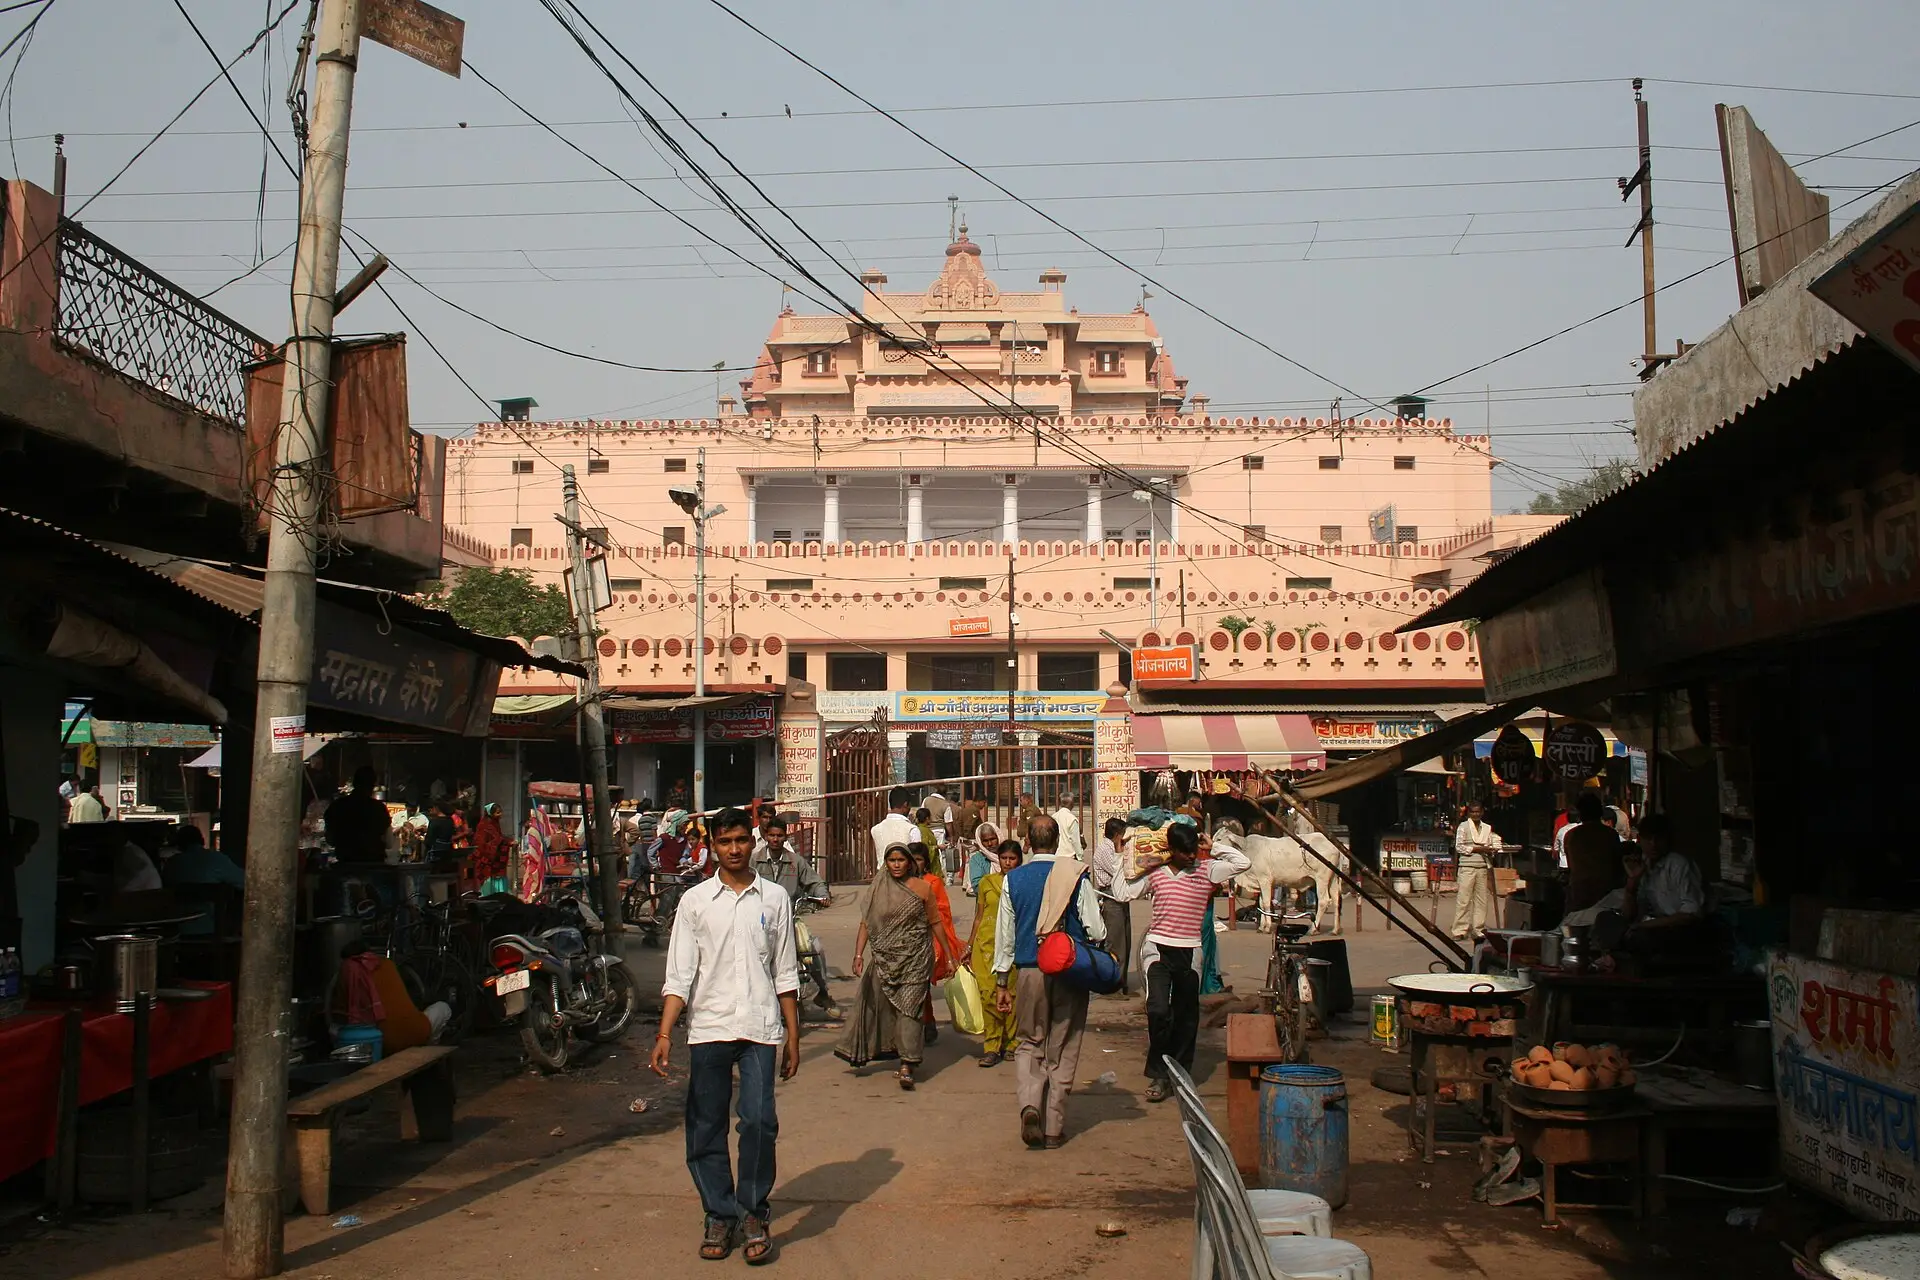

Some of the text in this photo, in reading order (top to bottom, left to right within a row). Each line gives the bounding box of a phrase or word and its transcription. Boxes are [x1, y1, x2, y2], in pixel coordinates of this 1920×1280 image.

[953, 620, 988, 632] भोजनालय
[1136, 653, 1187, 673] भोजनालय
[320, 649, 396, 706] मद्रास
[919, 699, 937, 713] श्री
[972, 701, 1010, 714] आश्रम
[1013, 698, 1046, 716] खादी
[1048, 703, 1098, 714] भण्डार
[779, 723, 817, 744] श्री कृष्ण
[1098, 722, 1110, 738] श्री
[1312, 719, 1375, 738] शिवम
[1376, 720, 1419, 738] फास्ट
[797, 747, 817, 760] स्थान
[1547, 736, 1599, 763] लस्सी
[786, 759, 807, 771] सेवा
[1102, 795, 1136, 809] मथुरा
[1800, 975, 1899, 1062] शर्मा
[1777, 1035, 1919, 1163] भोजनालय
[1804, 1134, 1907, 1194] शुद्ध शाकाहारी भोजन
